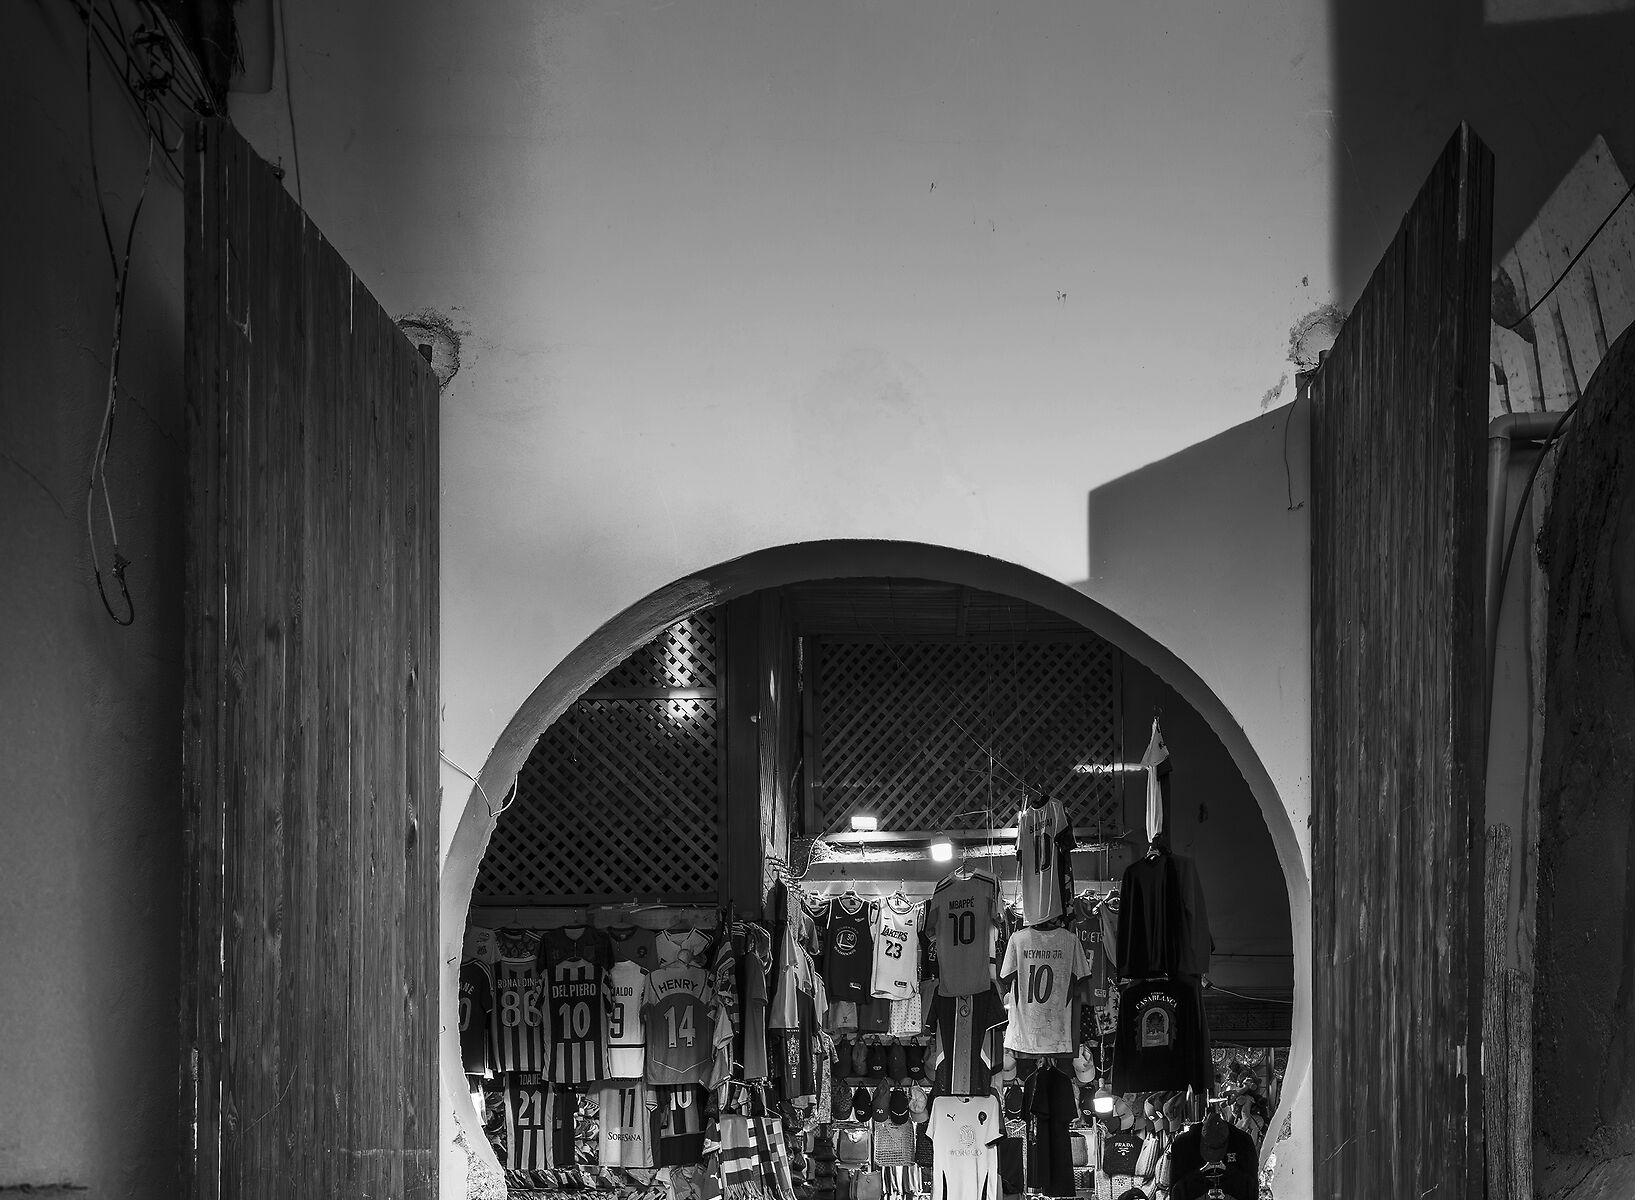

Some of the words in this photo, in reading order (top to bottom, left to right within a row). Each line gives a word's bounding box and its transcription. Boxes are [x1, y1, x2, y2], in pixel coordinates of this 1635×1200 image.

[881, 925, 908, 942] LAKERS
[949, 911, 976, 946] 10
[885, 940, 902, 959] 23
[552, 984, 569, 998] DEL
[570, 983, 597, 997] PIERO
[658, 979, 699, 994] HENRY
[1028, 964, 1054, 1004] 10
[1136, 995, 1177, 1010] CASABLANCA
[559, 1002, 591, 1039] 10
[610, 1002, 625, 1039] 9
[664, 1005, 696, 1048] 14
[518, 1090, 542, 1126] 21
[618, 1088, 636, 1127] 11
